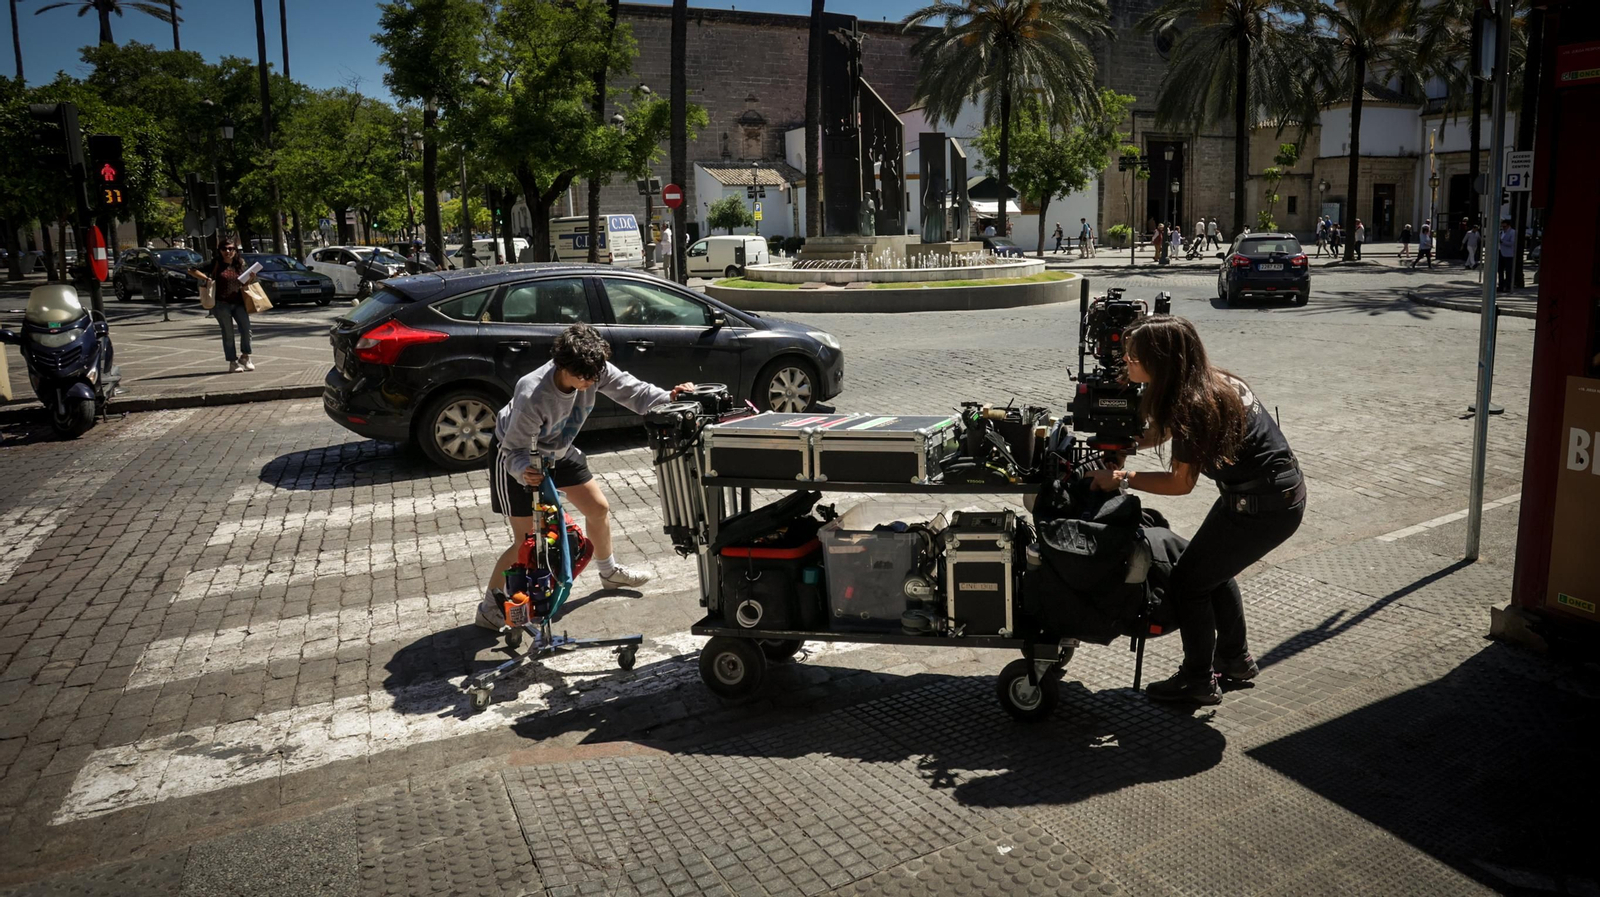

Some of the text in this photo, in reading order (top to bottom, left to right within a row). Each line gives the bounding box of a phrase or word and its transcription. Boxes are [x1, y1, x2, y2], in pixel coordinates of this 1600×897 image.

[1509, 175, 1518, 186] P
[104, 189, 122, 204] 37
[611, 217, 636, 230] C.D.C.
[1568, 598, 1594, 611] ONCE
